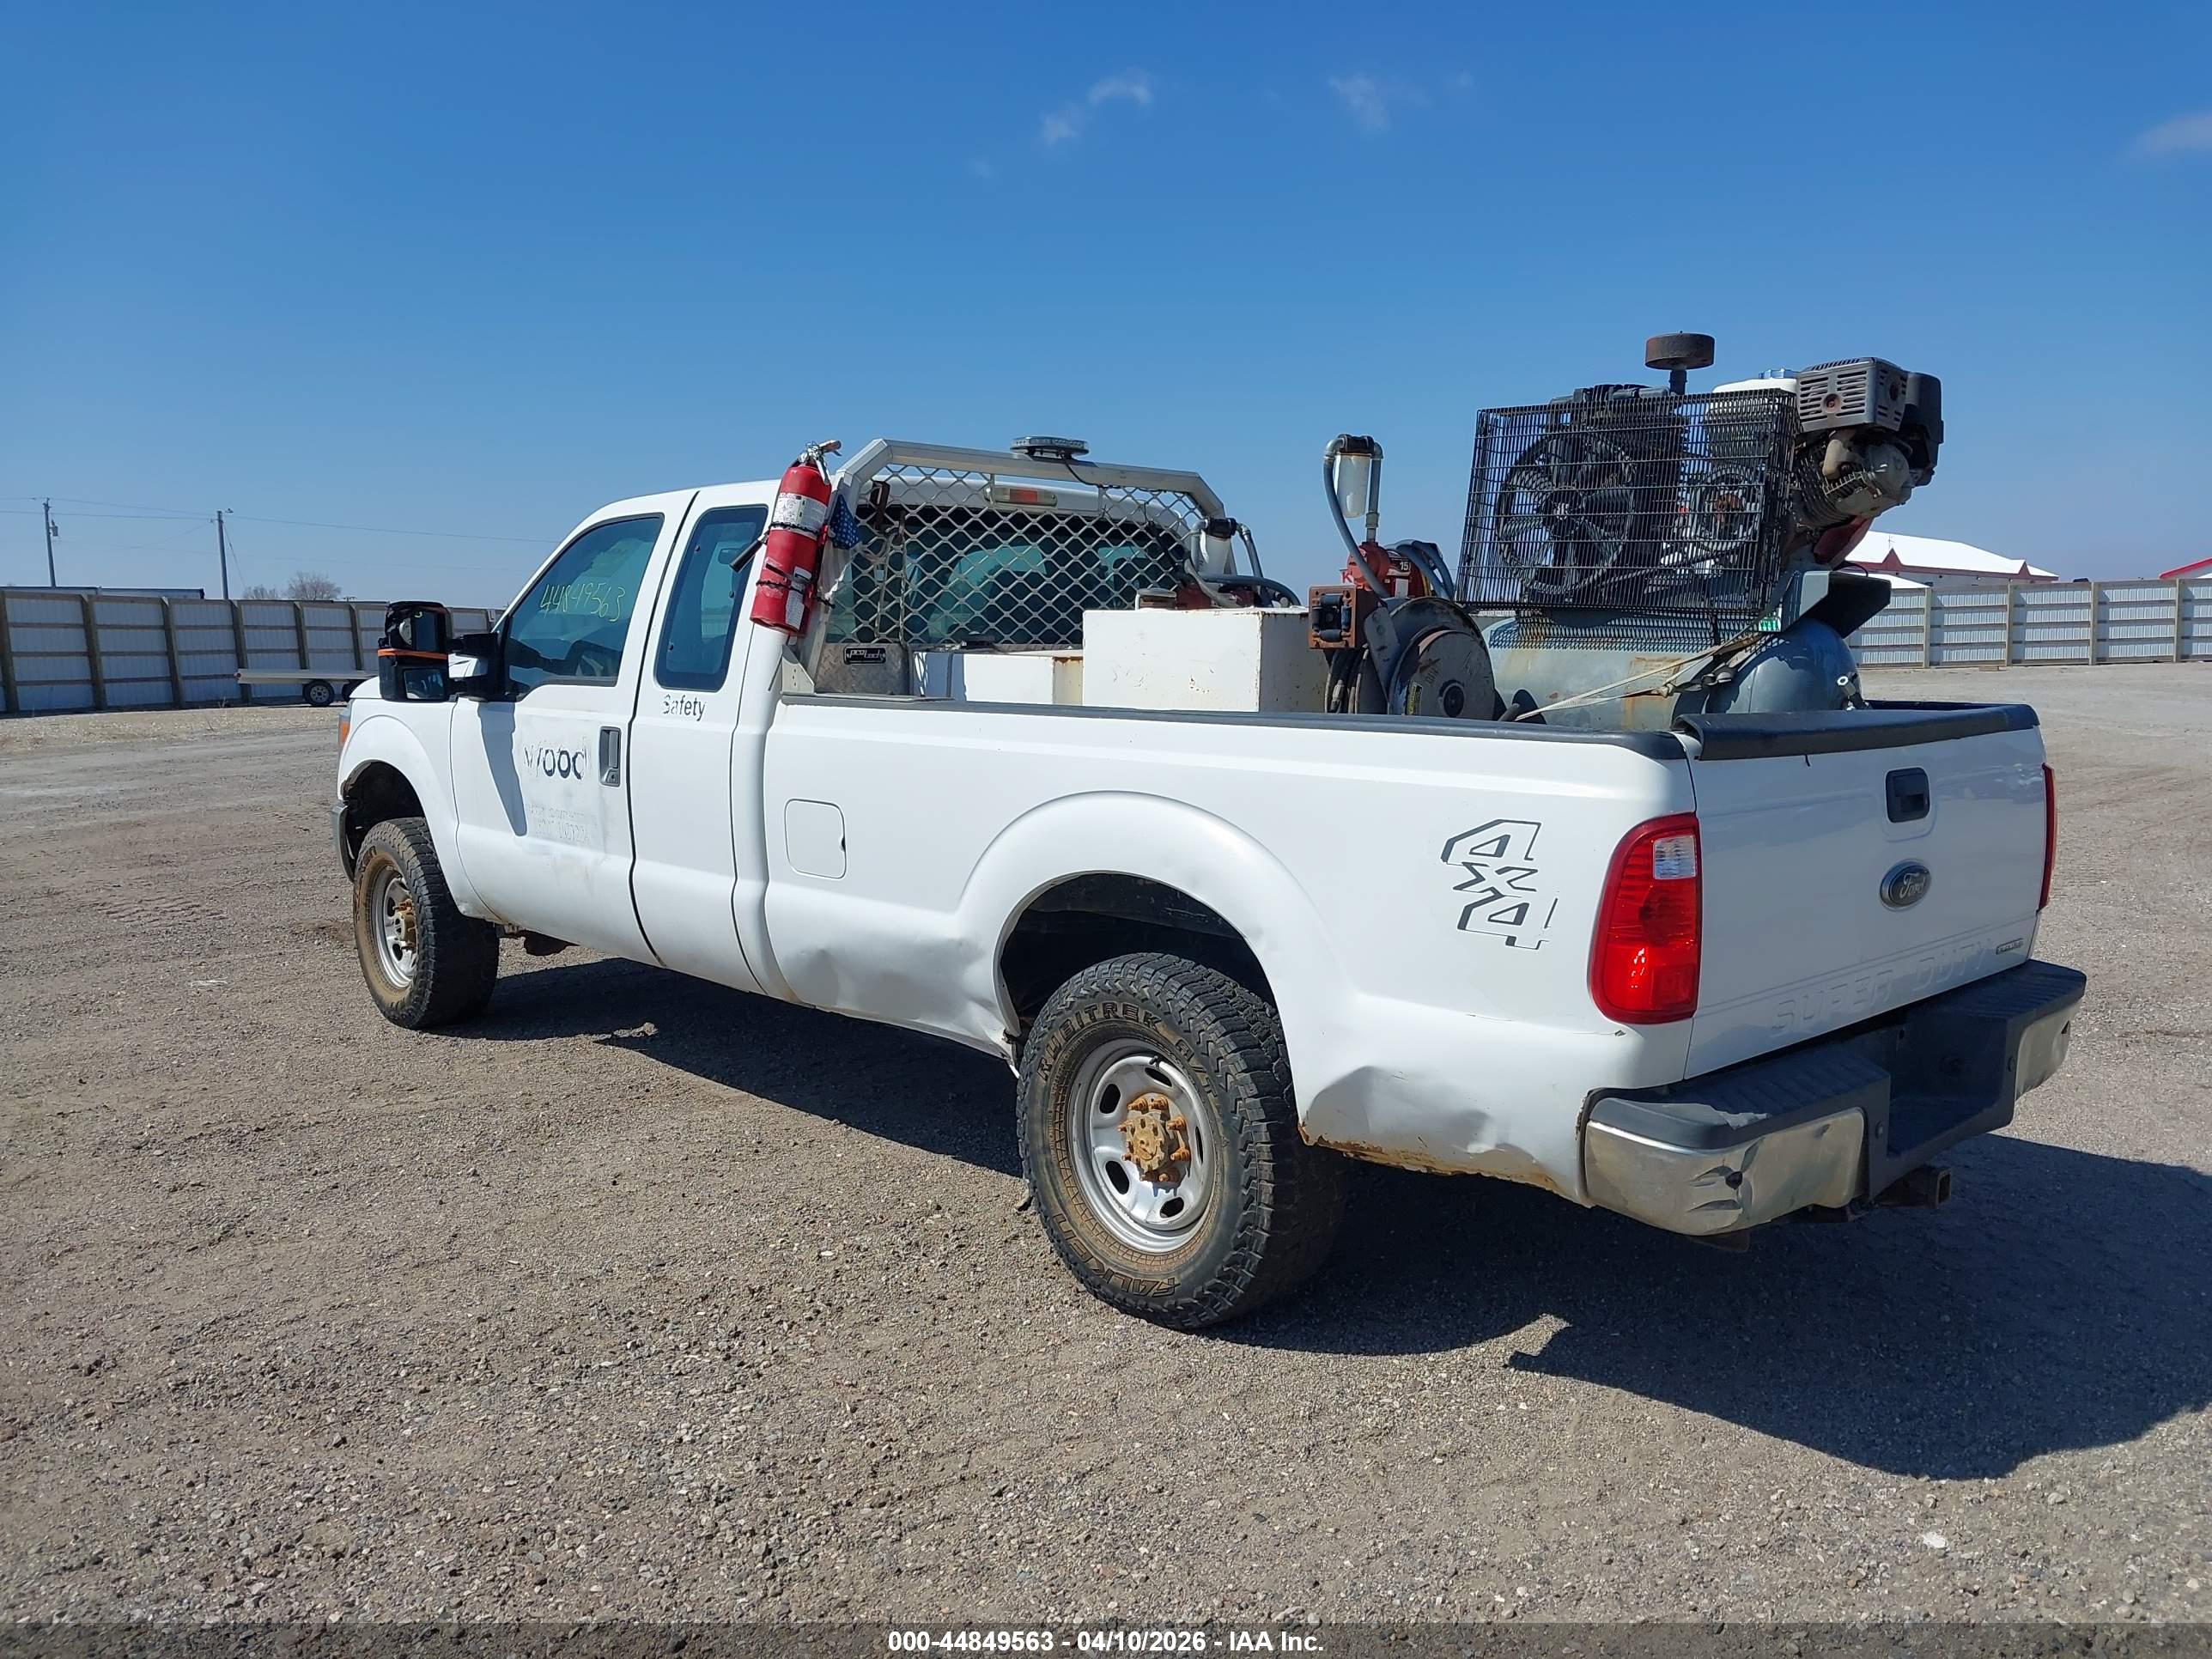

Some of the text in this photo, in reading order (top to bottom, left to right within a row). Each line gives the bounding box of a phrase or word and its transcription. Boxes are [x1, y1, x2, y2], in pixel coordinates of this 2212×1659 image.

[662, 694, 707, 722] Safety
[1899, 872, 1926, 899] Ford
[1770, 938, 1992, 1039] SUPER DUTY
[1036, 1000, 1163, 1081] RUBITREK
